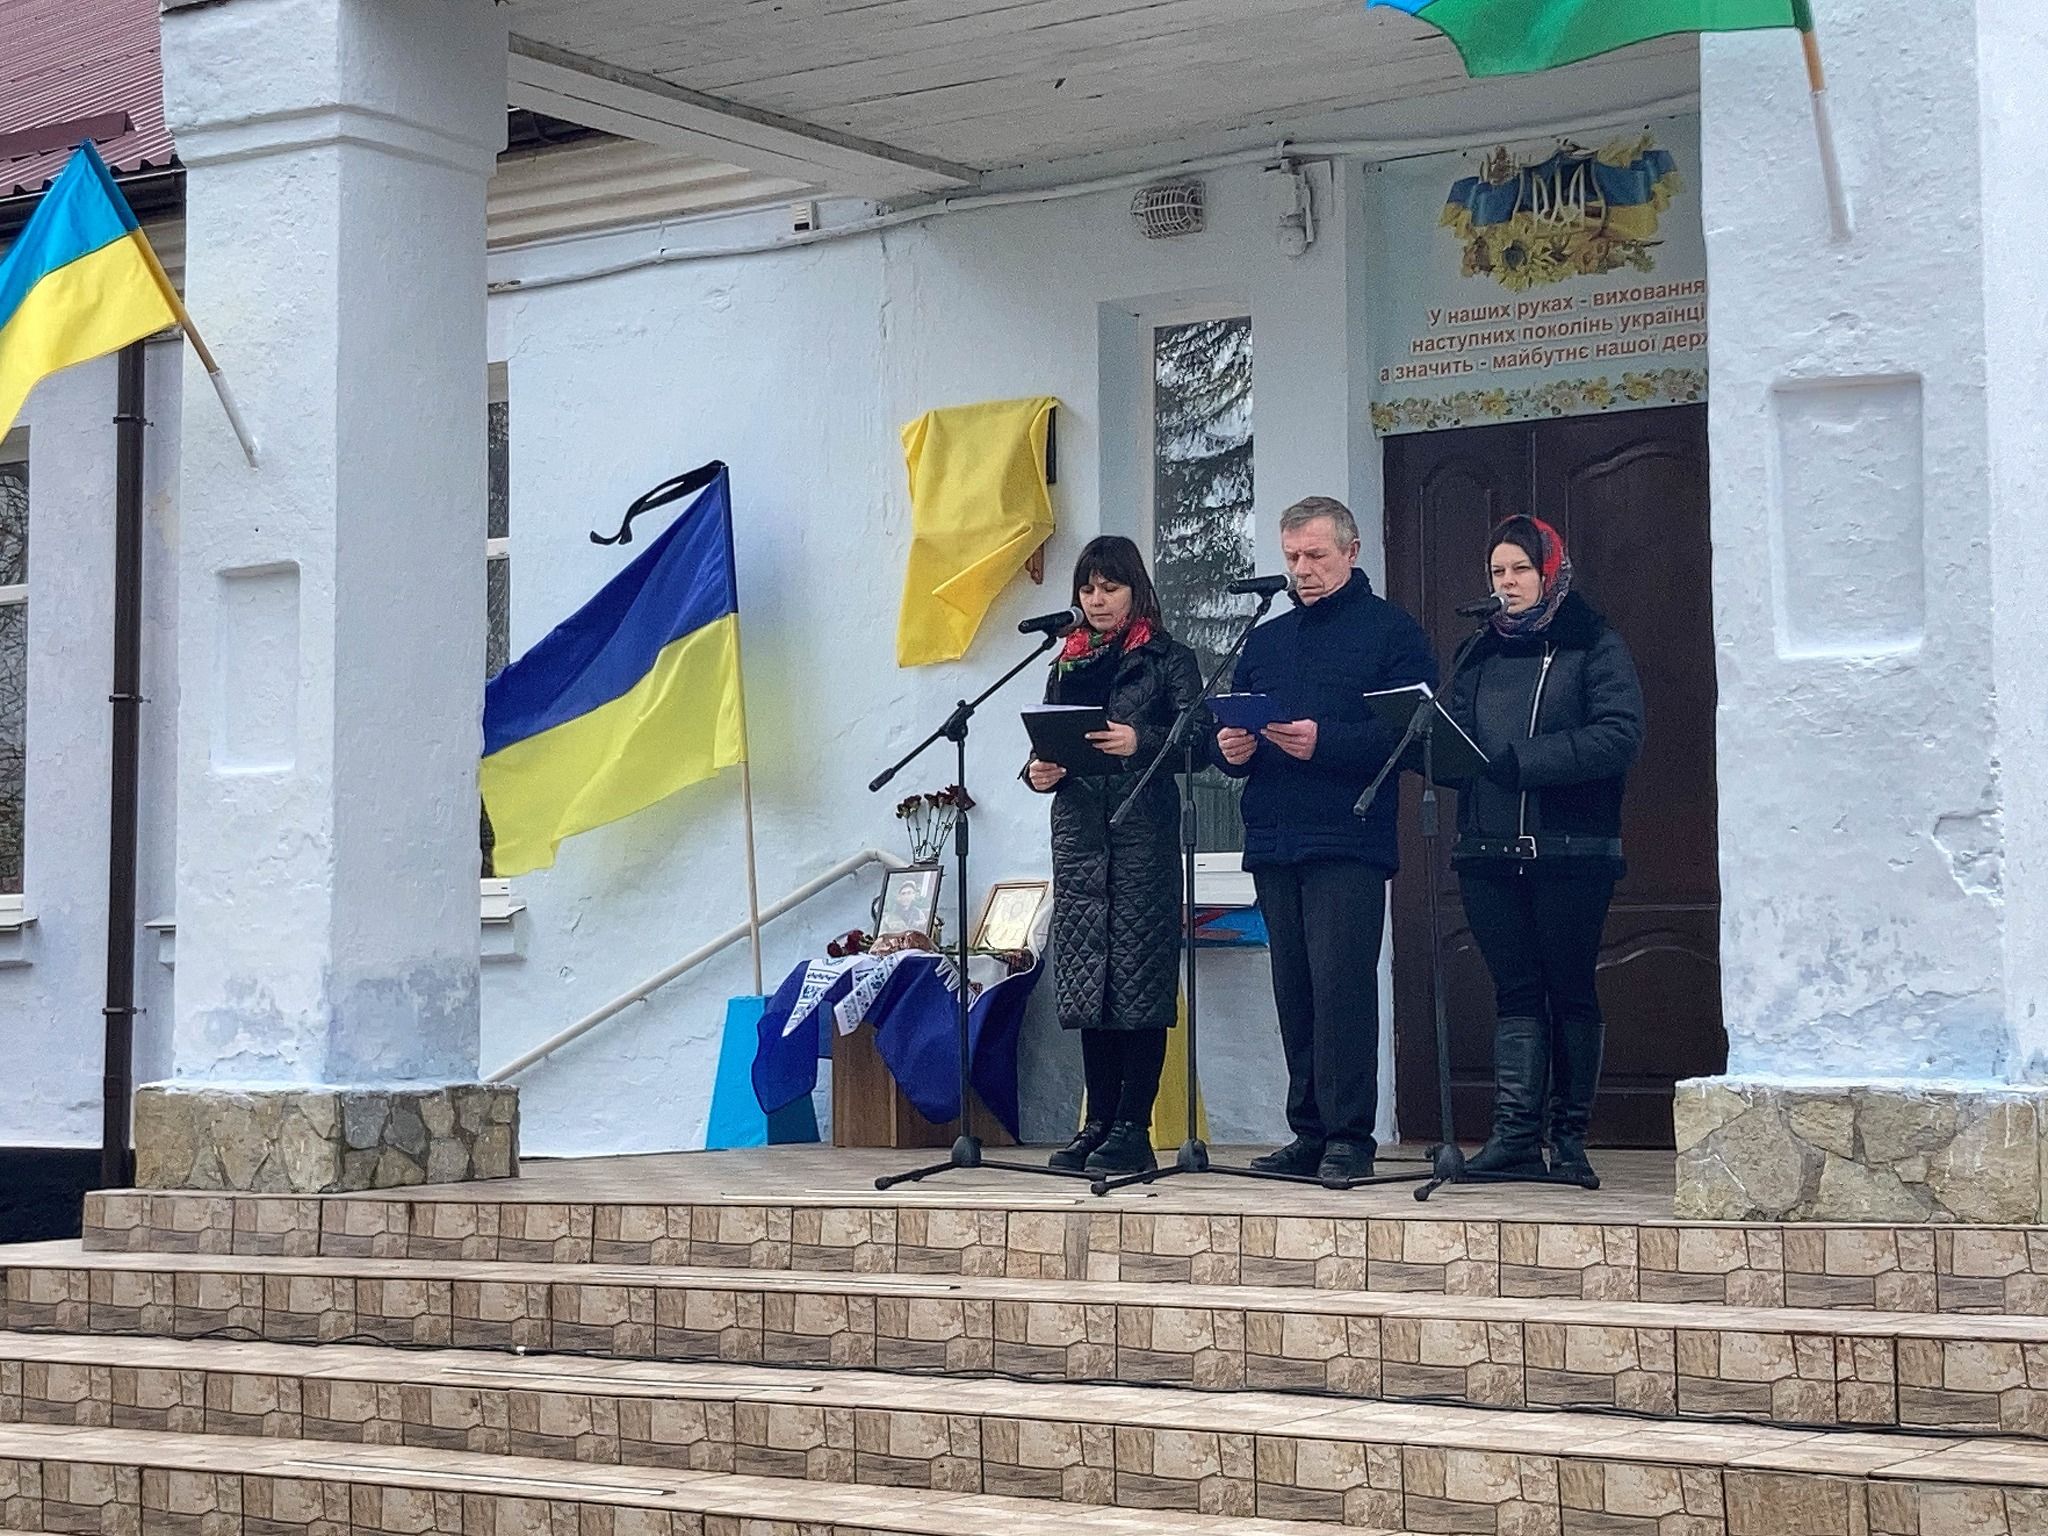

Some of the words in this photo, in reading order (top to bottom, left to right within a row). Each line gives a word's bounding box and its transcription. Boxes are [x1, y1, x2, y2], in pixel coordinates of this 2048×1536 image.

[1429, 308, 1442, 326] У
[1447, 304, 1511, 324] наших
[1516, 296, 1574, 320] руках
[1593, 279, 1706, 306] виховання
[1380, 368, 1390, 382] а
[1395, 359, 1474, 380] значить
[1492, 345, 1590, 369] майбутнє
[1596, 333, 1656, 357] нашої
[1412, 329, 1516, 353] наступних
[1522, 316, 1613, 341] поколінь
